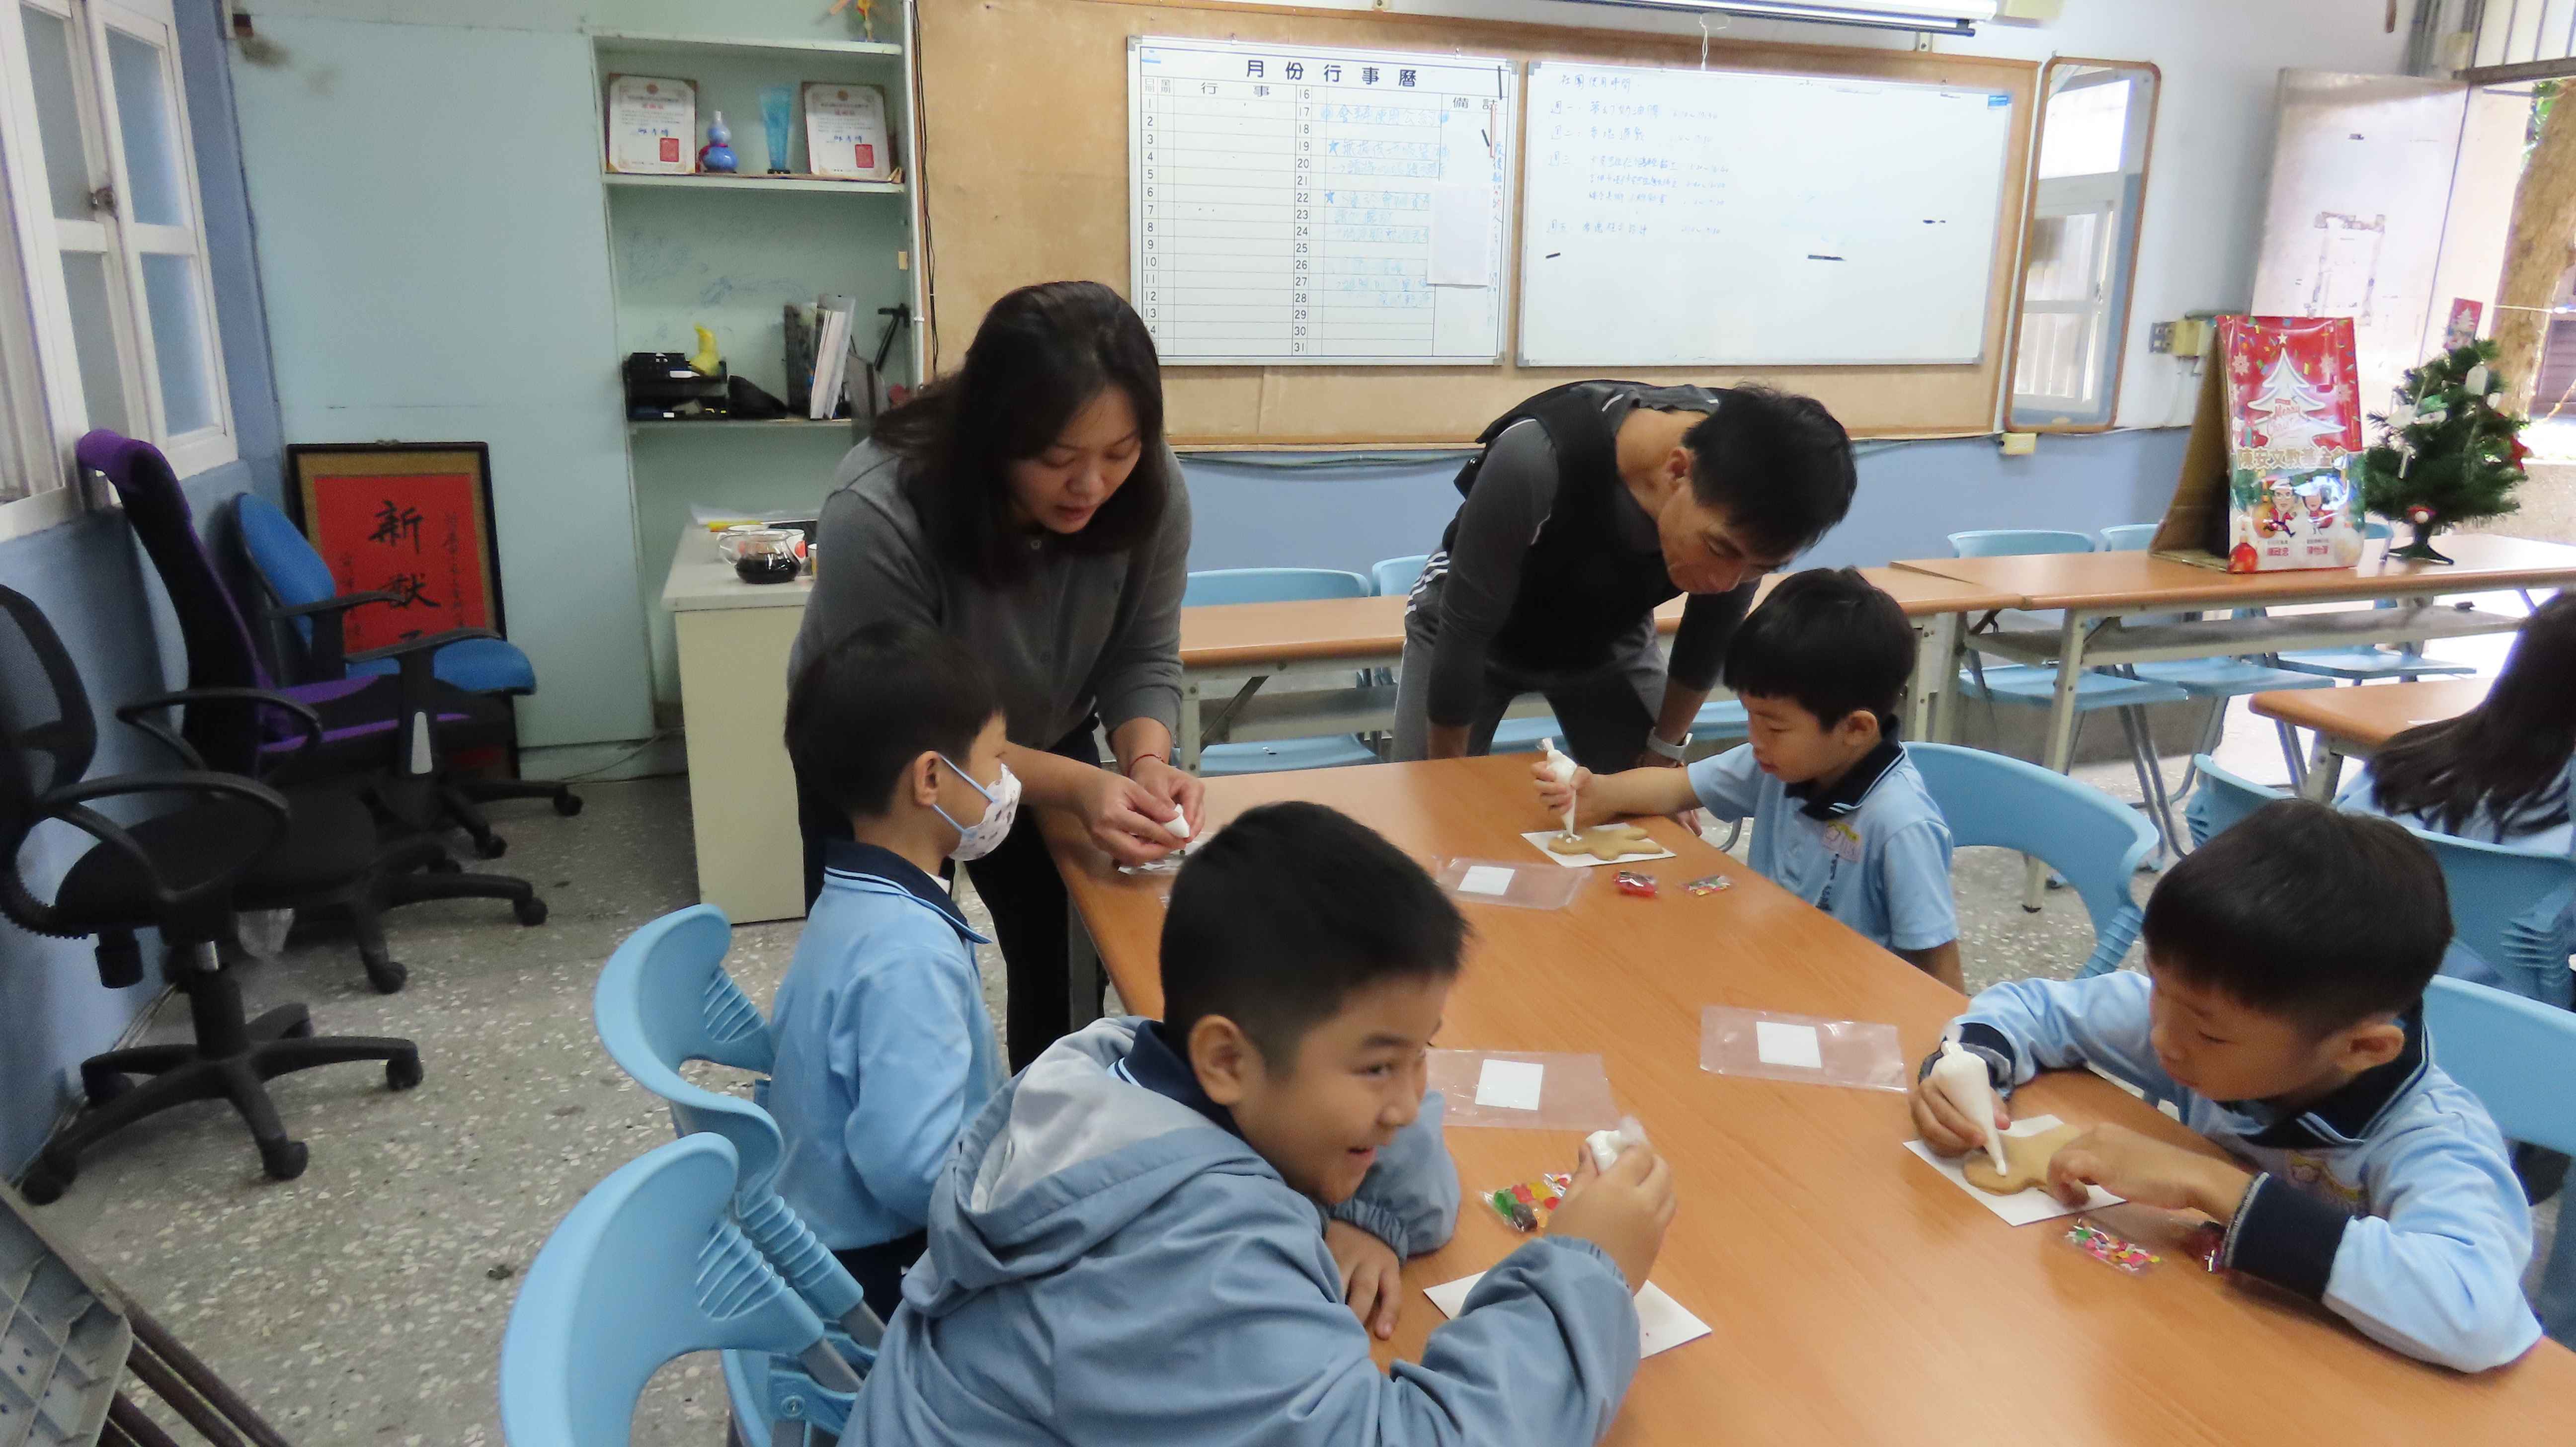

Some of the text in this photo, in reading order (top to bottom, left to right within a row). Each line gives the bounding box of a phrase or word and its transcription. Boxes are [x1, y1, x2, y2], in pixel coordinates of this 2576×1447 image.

[1246, 59, 1416, 87] 月份行事曆
[1300, 89, 1309, 99] 16
[1299, 107, 1309, 117] 17
[1147, 116, 1153, 126] 2
[1299, 124, 1309, 134] 18
[1147, 134, 1153, 144] 3
[1299, 141, 1309, 151] 19
[1147, 152, 1153, 161] 4
[1297, 158, 1309, 168] 20
[1148, 169, 1153, 179] 5
[1297, 175, 1307, 185] 21
[1147, 187, 1153, 197] 6
[1297, 192, 1308, 203] 22
[1148, 205, 1153, 215] 7
[1296, 209, 1308, 220] 23
[1147, 222, 1153, 232] 8
[1296, 226, 1308, 236] 24
[1147, 240, 1153, 249] 9
[1296, 242, 1307, 253] 25
[1146, 257, 1157, 266] 10
[1296, 259, 1307, 270] 26
[1146, 274, 1154, 284] 11
[1295, 275, 1307, 286] 27
[1146, 291, 1156, 301] 12
[1295, 293, 1306, 303] 28
[1146, 308, 1156, 318] 13
[1294, 310, 1306, 320] 29
[1294, 326, 1306, 336] 30
[1294, 342, 1305, 353] 31
